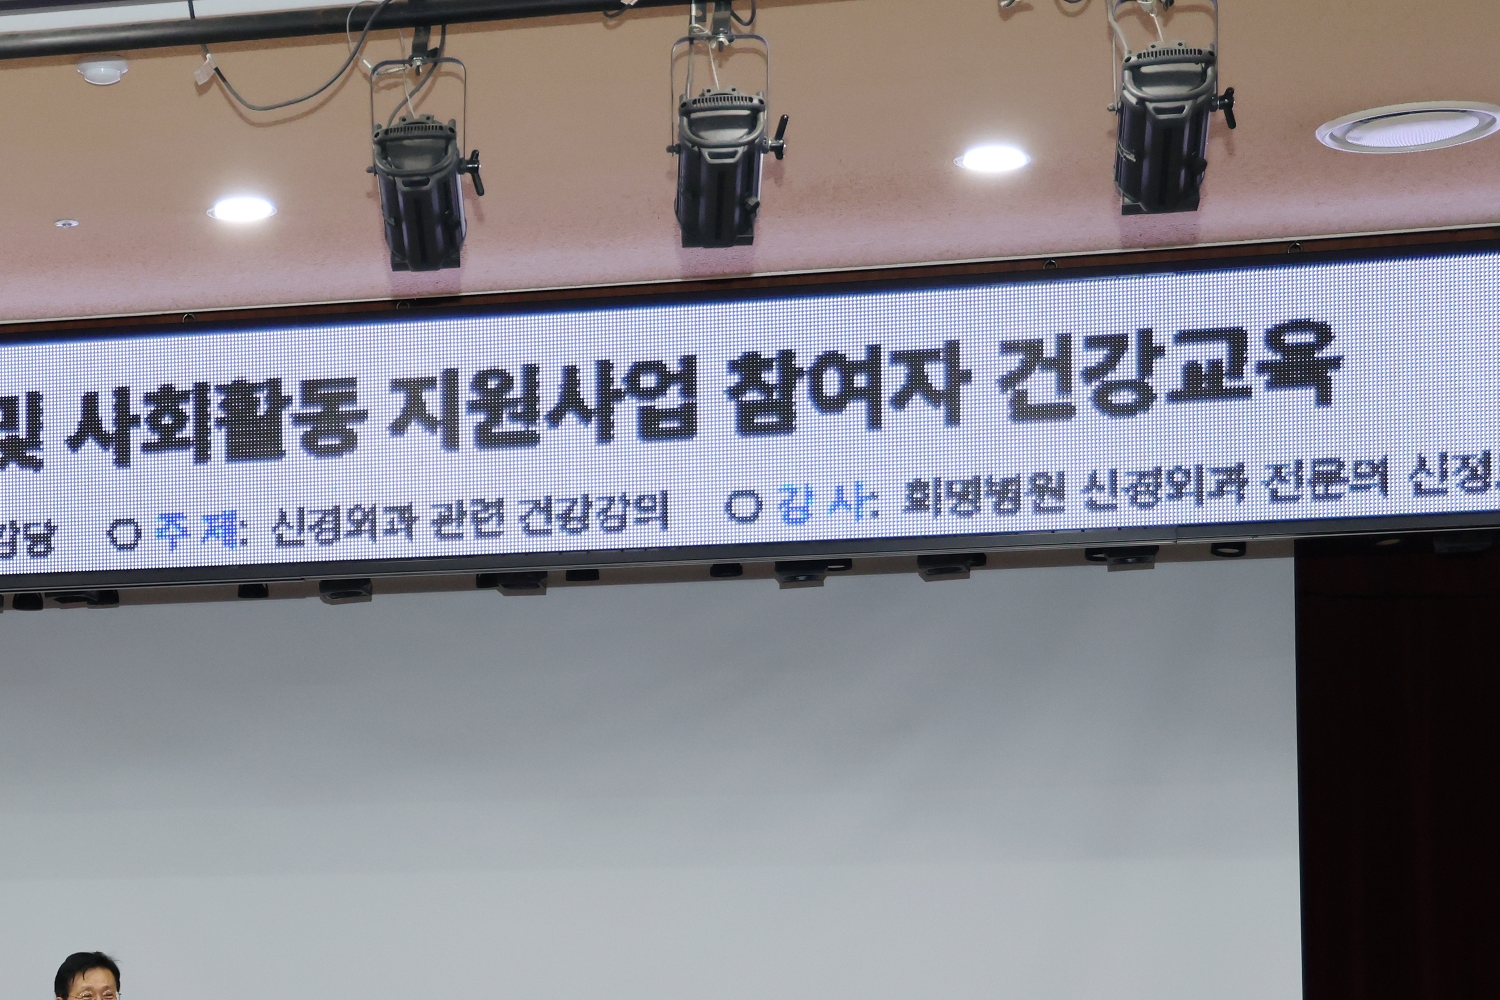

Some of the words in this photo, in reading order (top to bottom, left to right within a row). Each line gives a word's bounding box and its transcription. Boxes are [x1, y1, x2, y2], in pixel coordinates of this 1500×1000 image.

[65, 377, 368, 469] 사회활동
[389, 354, 697, 451] 지원사업
[725, 340, 972, 438] 참여자
[998, 318, 1344, 423] 건강교육
[904, 472, 1064, 517] 희명병원
[1083, 462, 1248, 511] 신경외과
[1263, 456, 1388, 503] 전문의
[1409, 450, 1500, 497] 신정
[273, 504, 417, 548] 신경외과
[431, 498, 504, 540] 관련
[520, 491, 668, 536] 건강강의
